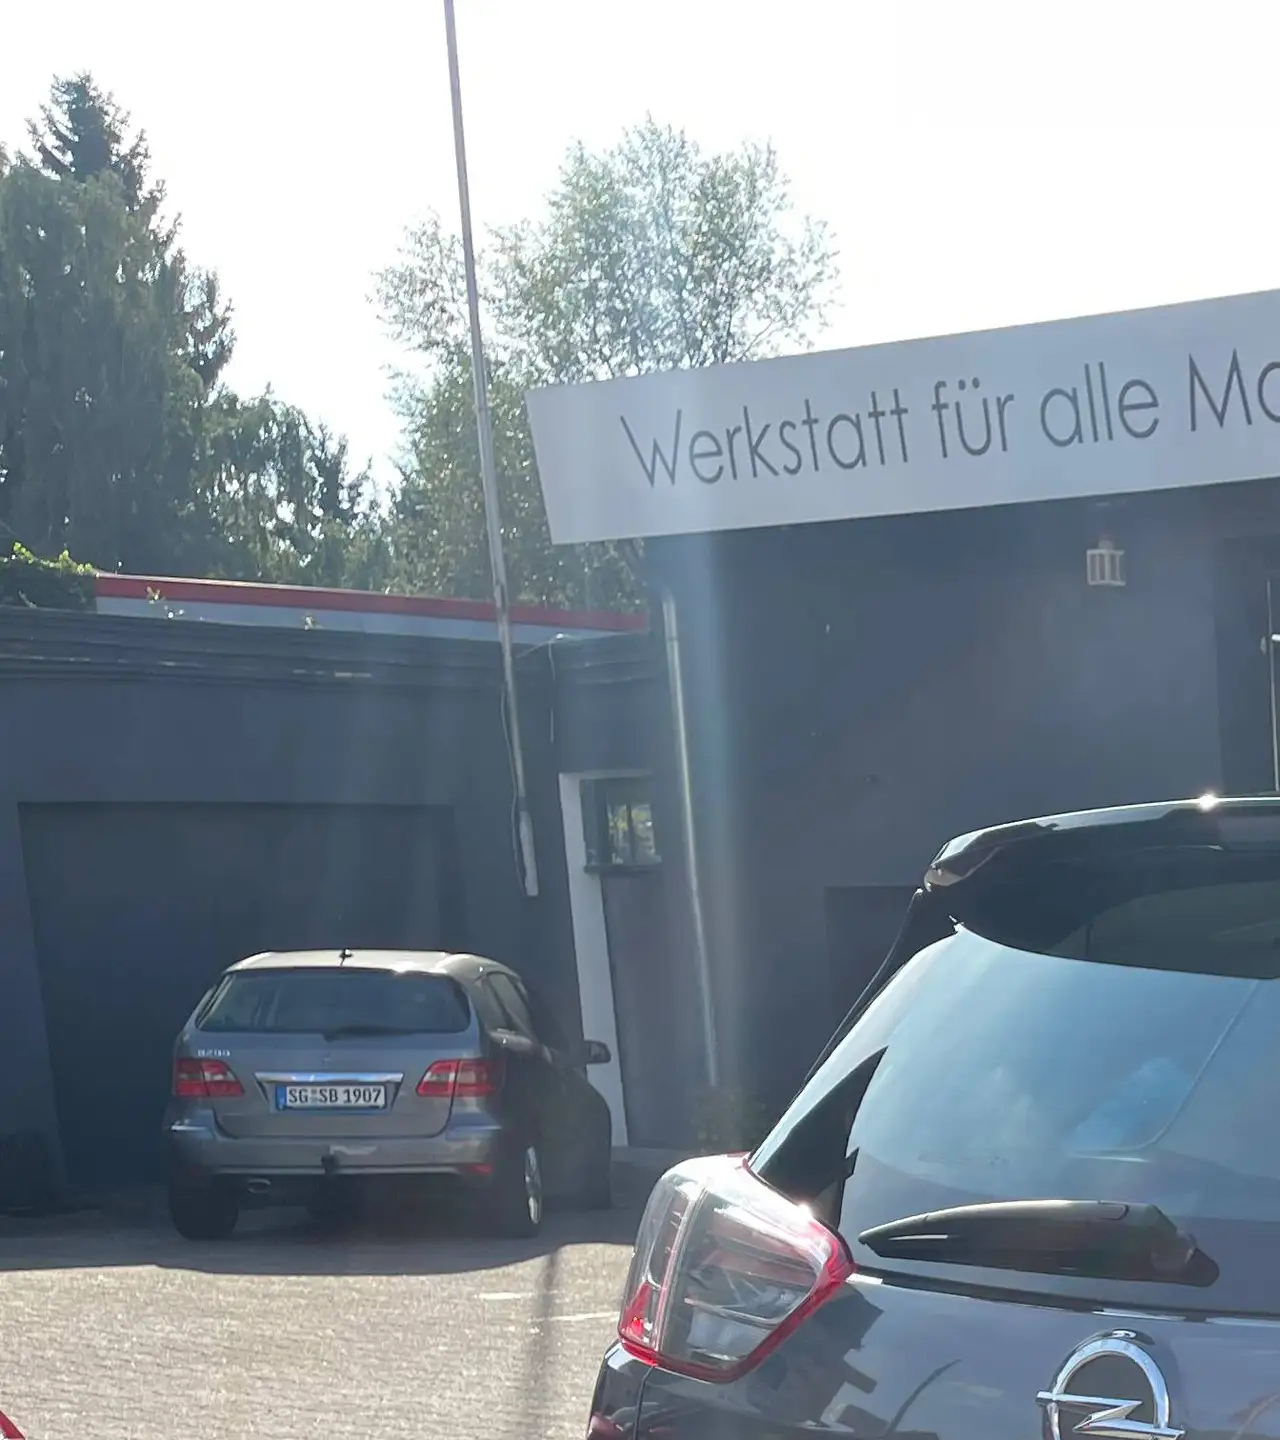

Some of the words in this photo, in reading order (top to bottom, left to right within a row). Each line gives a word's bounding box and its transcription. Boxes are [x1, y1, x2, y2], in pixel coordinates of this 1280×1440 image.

[620, 388, 908, 488] Werkstatt
[931, 376, 1014, 458] für
[1040, 361, 1159, 447] alle
[288, 1088, 309, 1104] SG
[319, 1088, 338, 1104] SB
[343, 1088, 382, 1104] 1907
